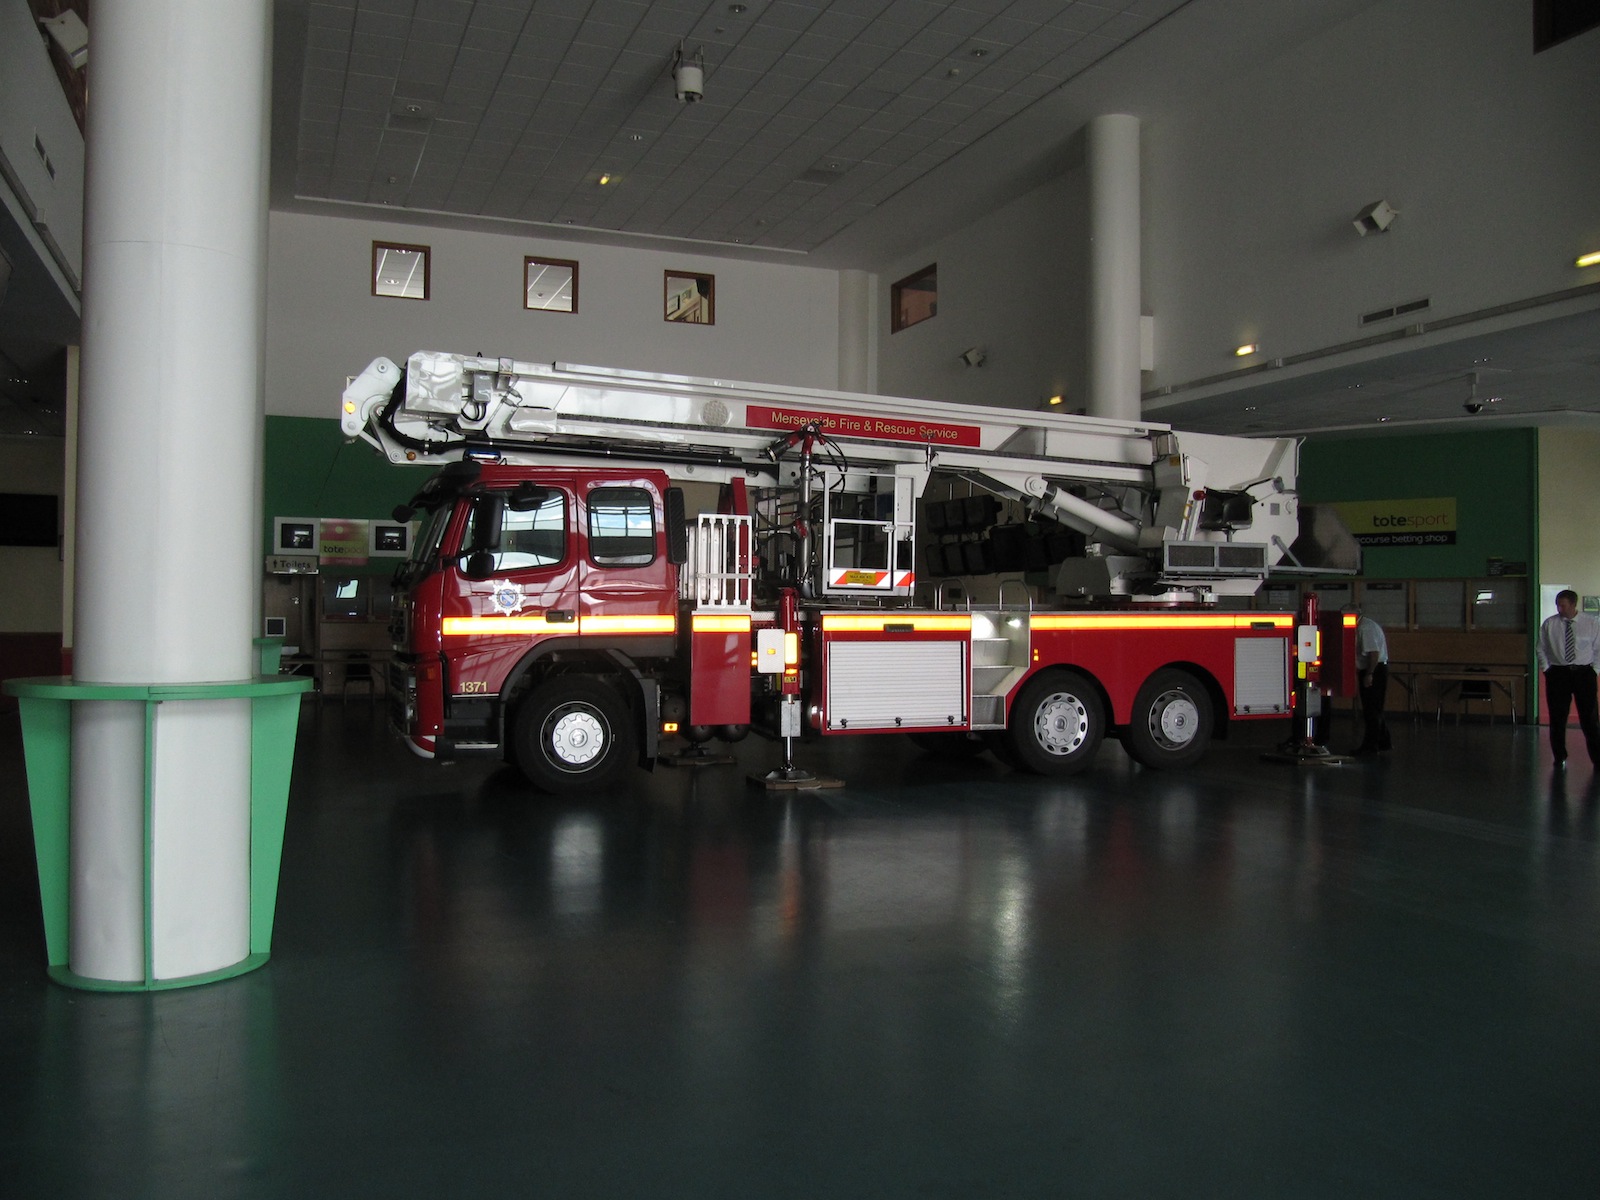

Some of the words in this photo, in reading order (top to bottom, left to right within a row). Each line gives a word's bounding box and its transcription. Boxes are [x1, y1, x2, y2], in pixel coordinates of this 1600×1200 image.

[839, 418, 861, 431] Fire
[864, 420, 872, 432] &
[875, 421, 916, 435] Rescue
[919, 425, 958, 440] Service
[1373, 513, 1449, 528] totesport
[1391, 534, 1423, 545] betting
[1424, 534, 1448, 543] shop
[280, 560, 311, 569] Toilets
[460, 682, 487, 692] 1371
